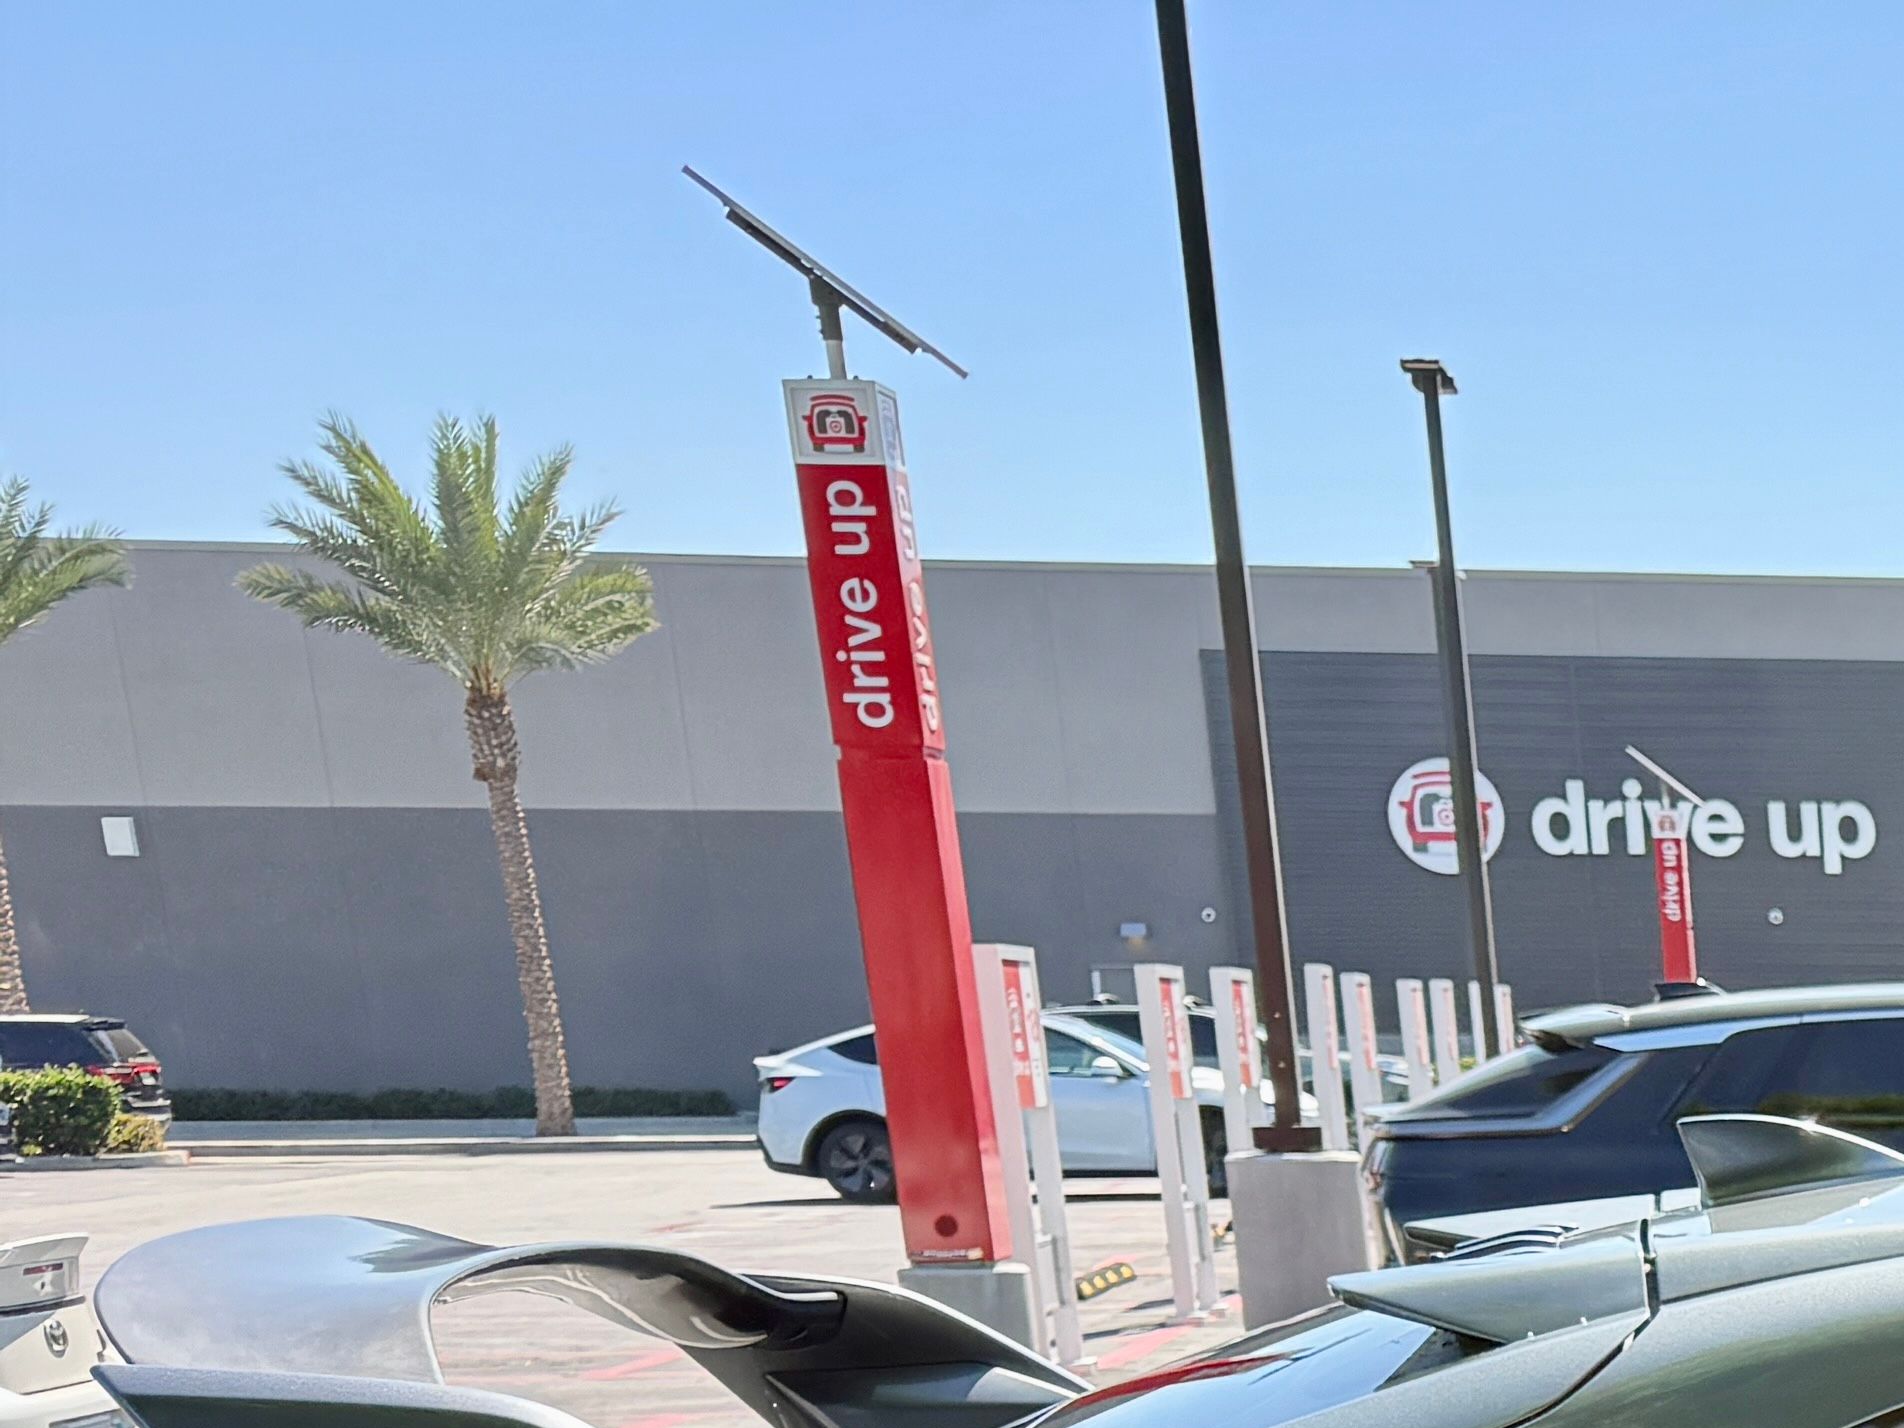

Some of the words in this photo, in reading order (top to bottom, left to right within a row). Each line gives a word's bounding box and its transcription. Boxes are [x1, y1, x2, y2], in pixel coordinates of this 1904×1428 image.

[825, 479, 877, 556] up
[836, 576, 895, 729] drive
[908, 581, 939, 733] drive
[1531, 778, 1745, 857] drive
[1767, 800, 1877, 875] up
[1660, 840, 1680, 868] up
[1660, 869, 1682, 922] drive
